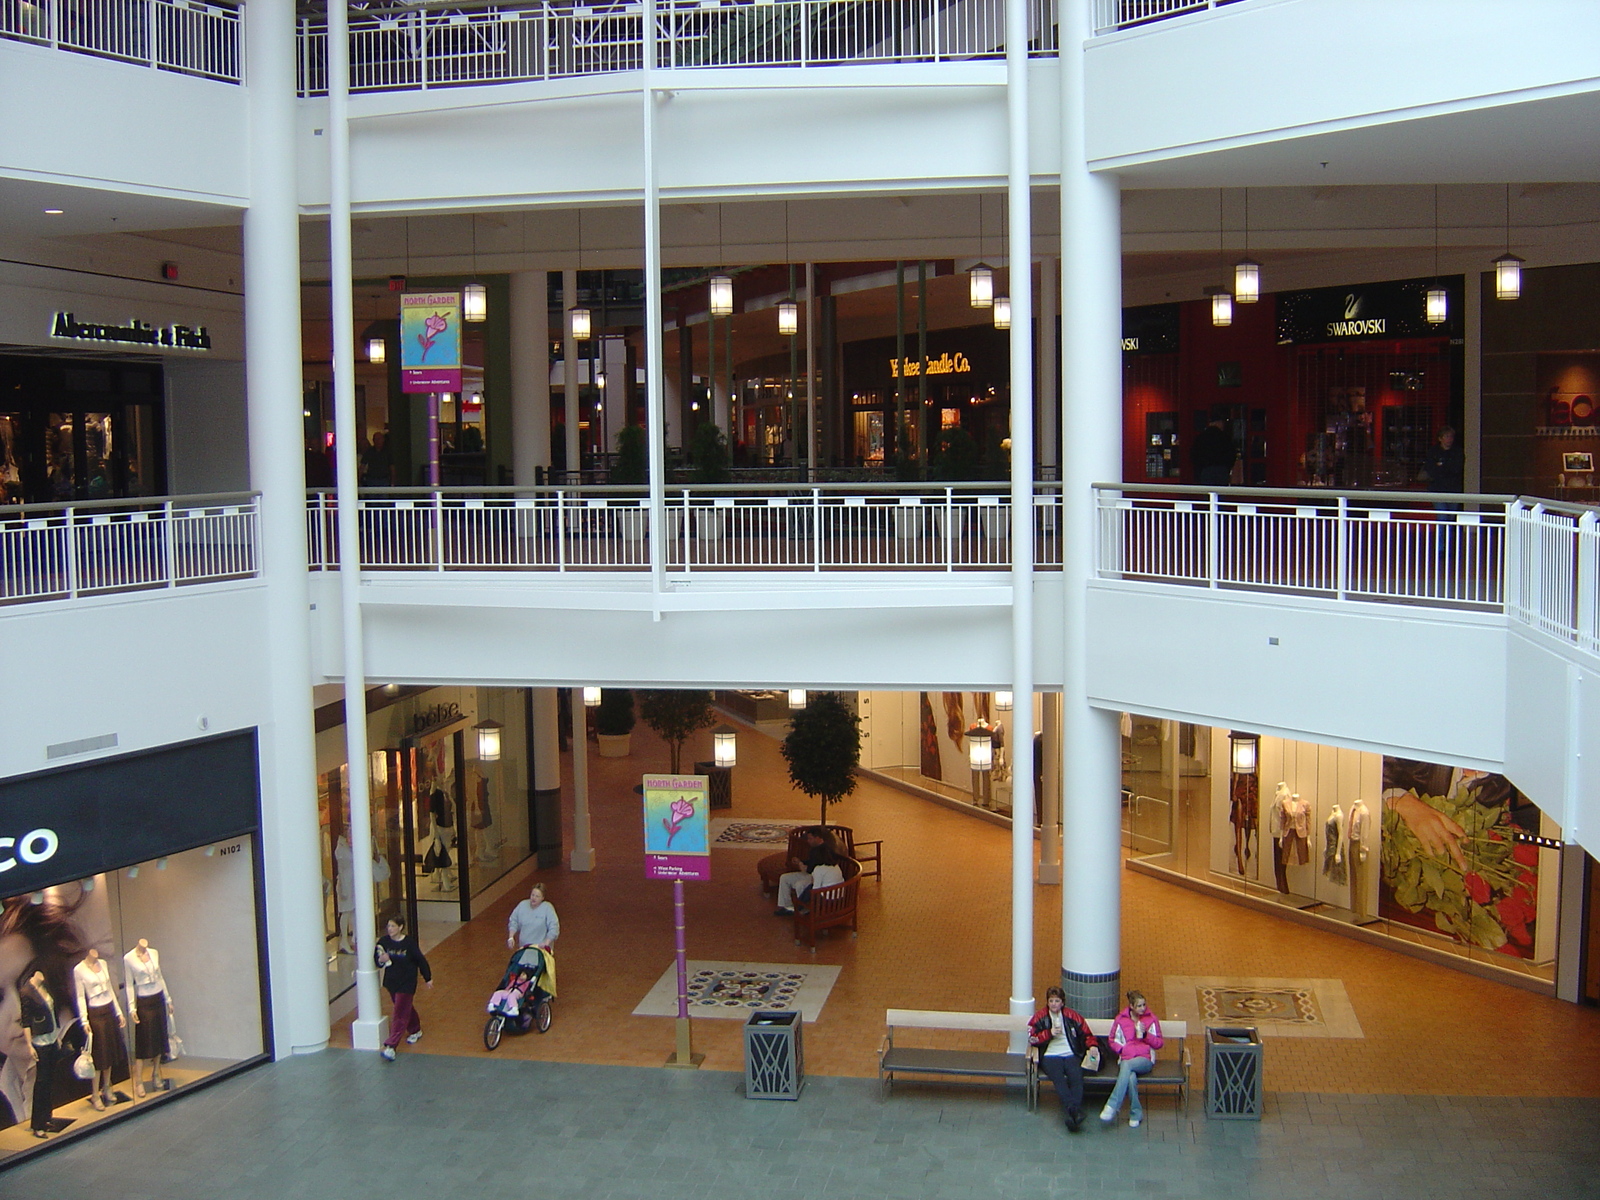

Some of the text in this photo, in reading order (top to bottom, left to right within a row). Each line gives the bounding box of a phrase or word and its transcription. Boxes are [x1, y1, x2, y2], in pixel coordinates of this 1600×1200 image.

[404, 297, 426, 305] NORTH
[1327, 318, 1386, 337] SWAROVSKI
[925, 352, 954, 375] andle
[413, 702, 460, 732] bebe
[647, 779, 671, 788] NORTH
[220, 844, 241, 856] N102
